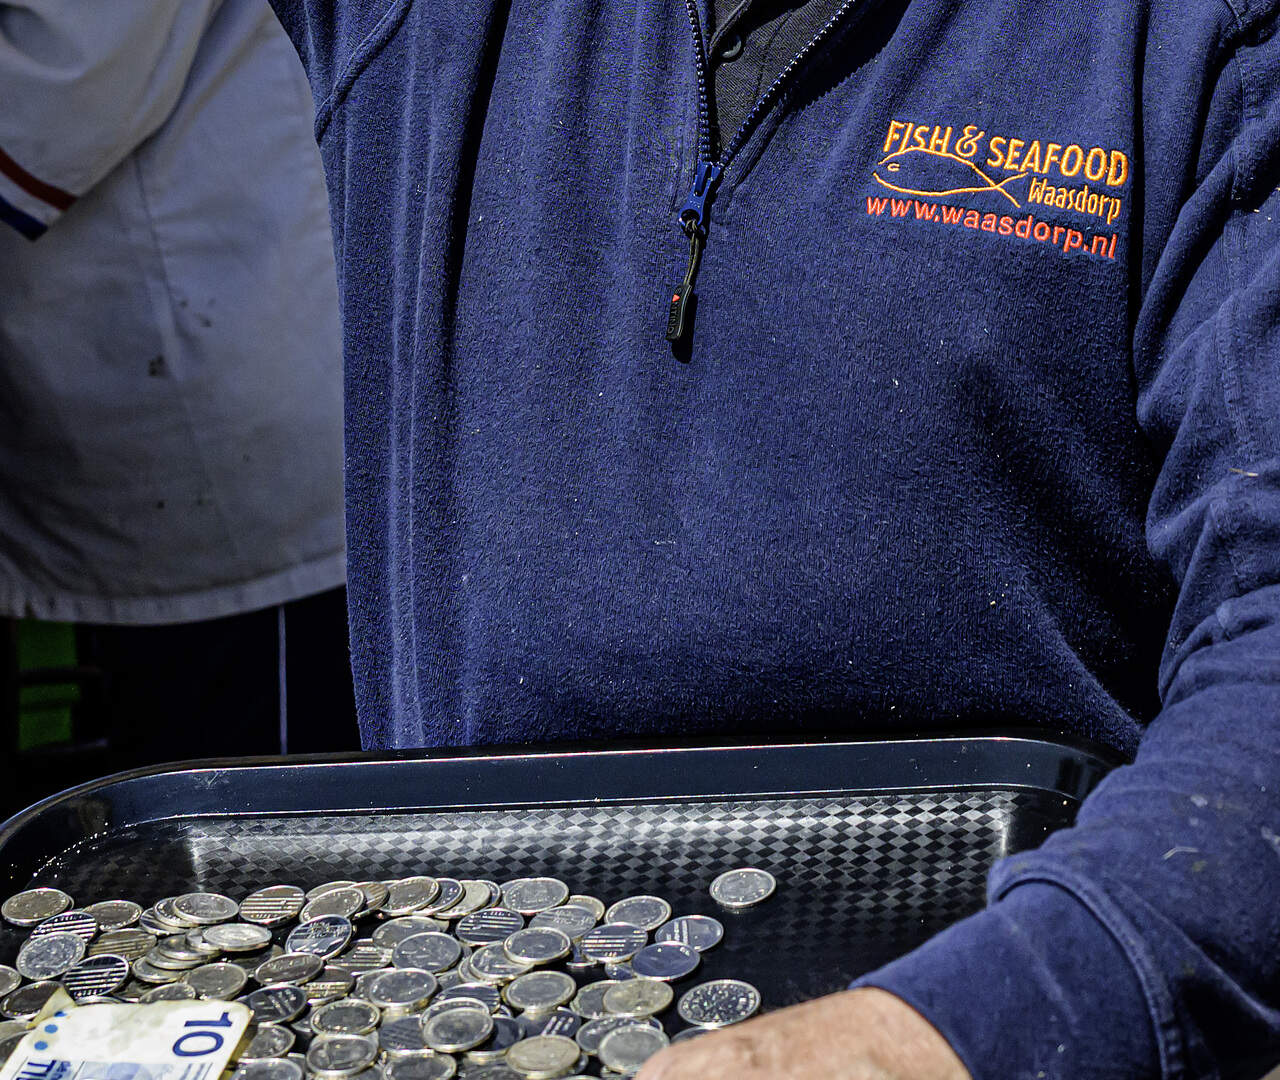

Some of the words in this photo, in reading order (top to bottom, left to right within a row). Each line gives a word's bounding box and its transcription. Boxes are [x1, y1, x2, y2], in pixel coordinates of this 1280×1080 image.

[883, 120, 952, 154] FISH
[955, 125, 984, 157] &
[987, 136, 1128, 186] SEAFOOD
[866, 196, 1117, 259] www.waasdorp.nl
[1028, 177, 1121, 225] Waasdorp
[172, 1012, 232, 1057] 10
